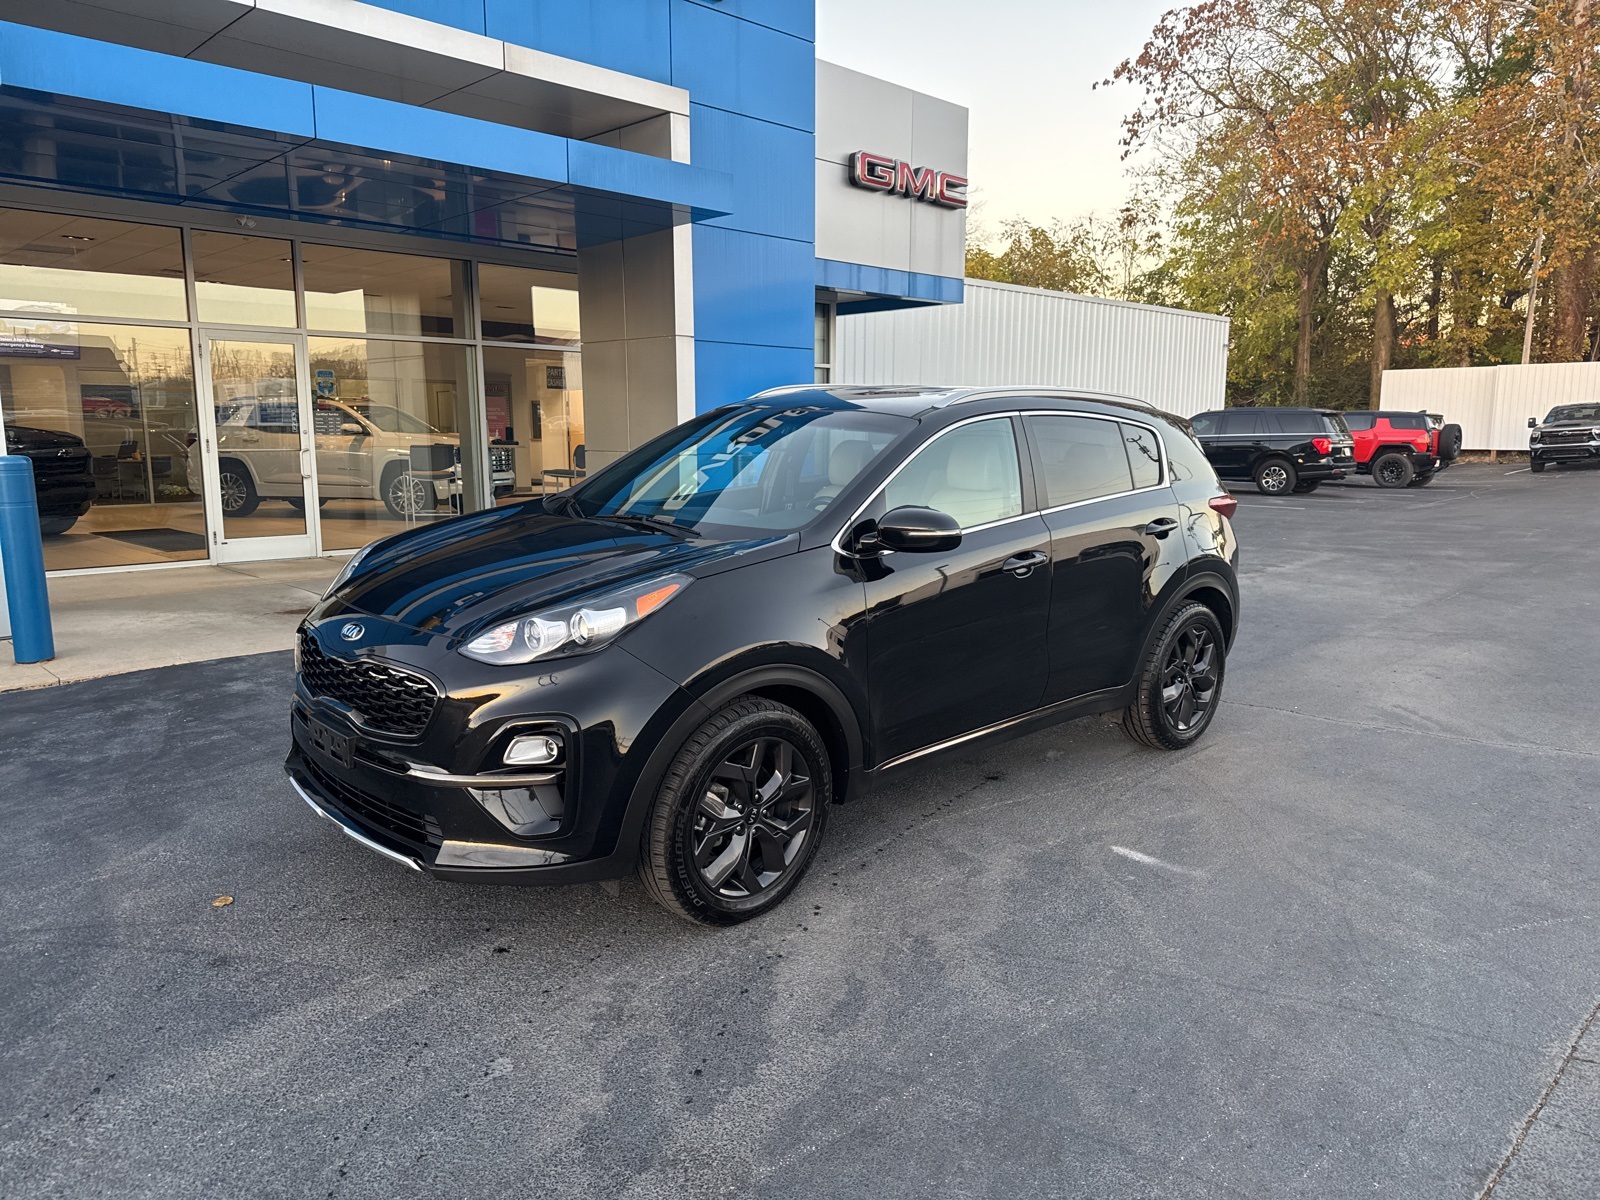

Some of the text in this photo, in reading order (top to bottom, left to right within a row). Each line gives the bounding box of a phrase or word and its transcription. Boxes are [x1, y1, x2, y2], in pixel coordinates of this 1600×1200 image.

[853, 150, 968, 208] GMC
[547, 368, 566, 377] PARTS
[342, 624, 361, 639] KIA
[748, 808, 758, 824] KIA
